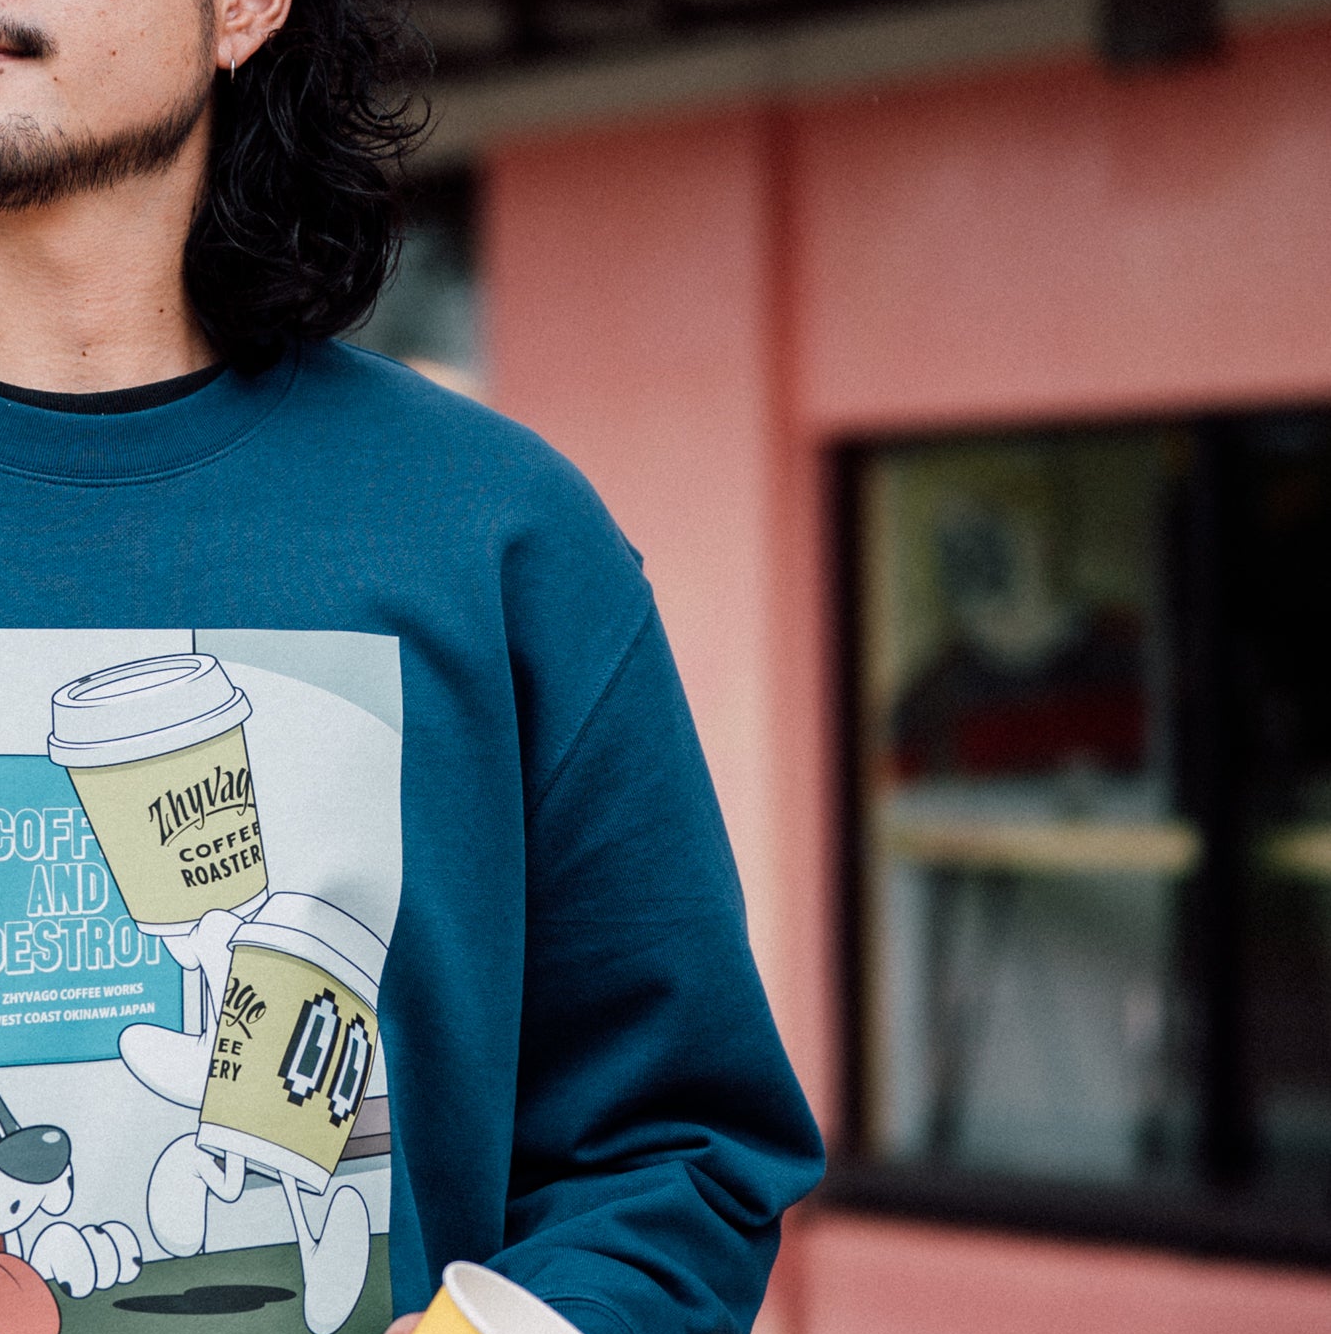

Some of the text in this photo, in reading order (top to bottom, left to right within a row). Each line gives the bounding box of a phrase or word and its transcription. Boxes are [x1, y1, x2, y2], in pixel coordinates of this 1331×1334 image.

[148, 765, 251, 846] Zhyvag
[181, 844, 262, 887] ROASTER
[26, 861, 109, 918] AND
[2, 982, 144, 1005] ZHYVAGO COFFEE WORKS
[24, 1010, 61, 1024] COAST
[64, 1006, 118, 1021] OKINAWA
[119, 1002, 156, 1017] JAPAN
